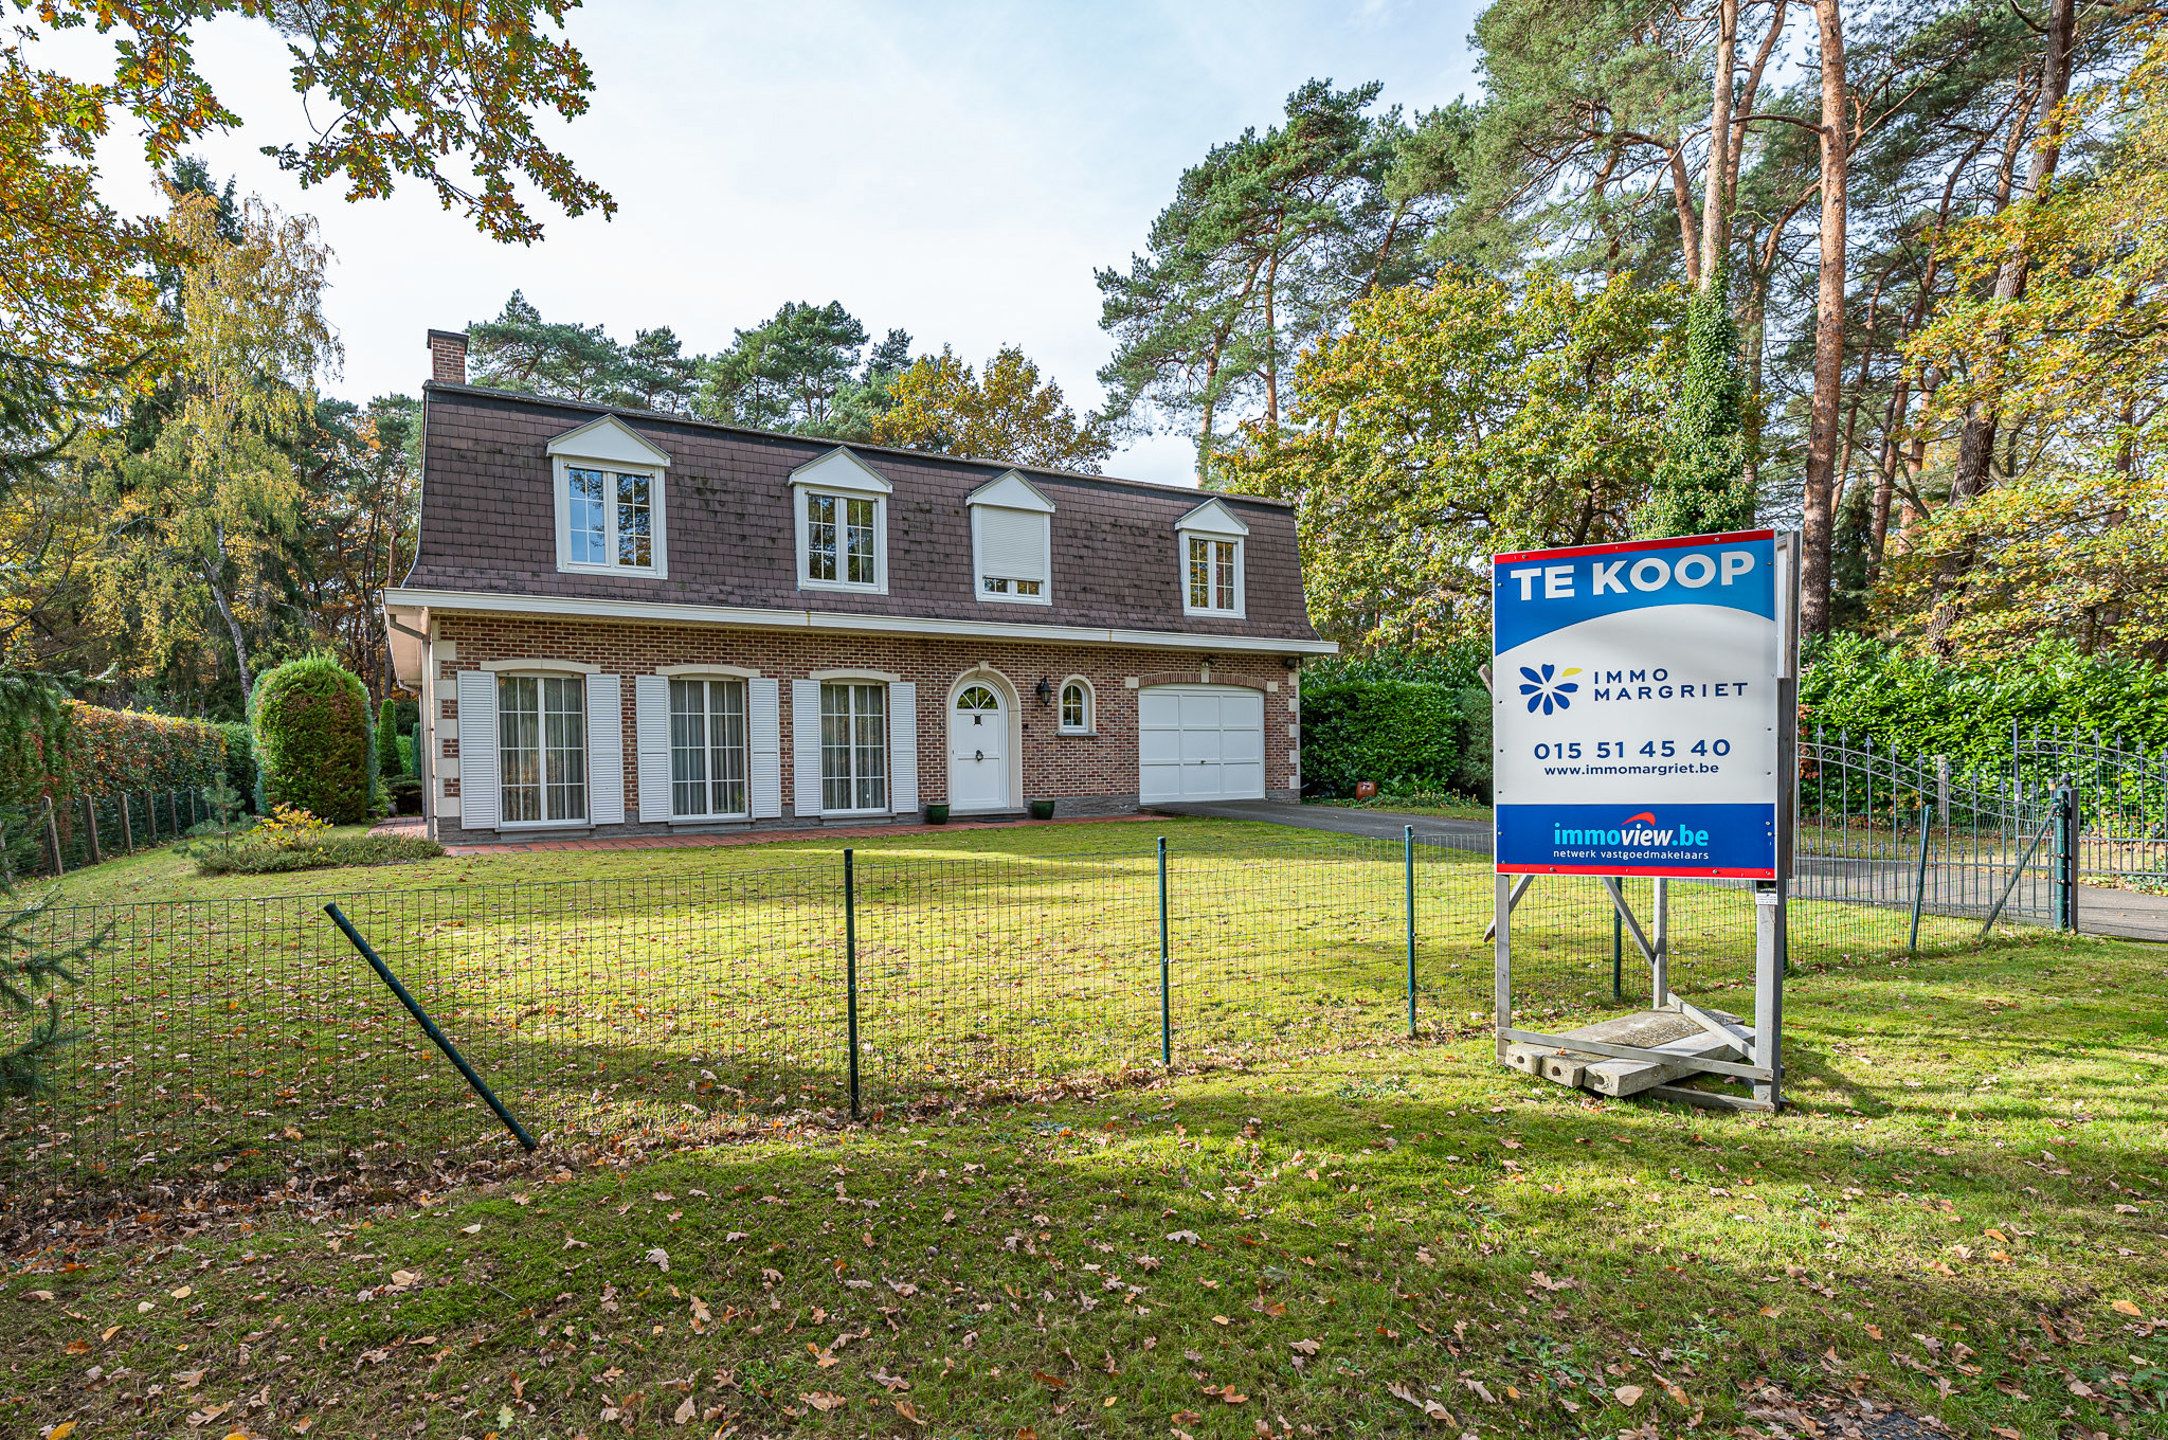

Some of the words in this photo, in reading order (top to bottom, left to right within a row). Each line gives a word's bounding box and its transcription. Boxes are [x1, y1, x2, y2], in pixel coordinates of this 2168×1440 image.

[1510, 565, 1575, 601] TE
[1592, 551, 1755, 596] KOOP
[1594, 668, 1668, 684] IMMO
[1594, 682, 1748, 702] MARGRIET
[1534, 742, 1582, 759] 015
[1597, 741, 1624, 759] 51
[1639, 740, 1676, 758] 45
[1690, 738, 1731, 757] 40
[1544, 763, 1720, 776] www.immomargriet.be
[1554, 822, 1709, 847] immoview.be
[1553, 849, 1596, 859] netwerk
[1600, 849, 1709, 861] vastgoedmakelaars
